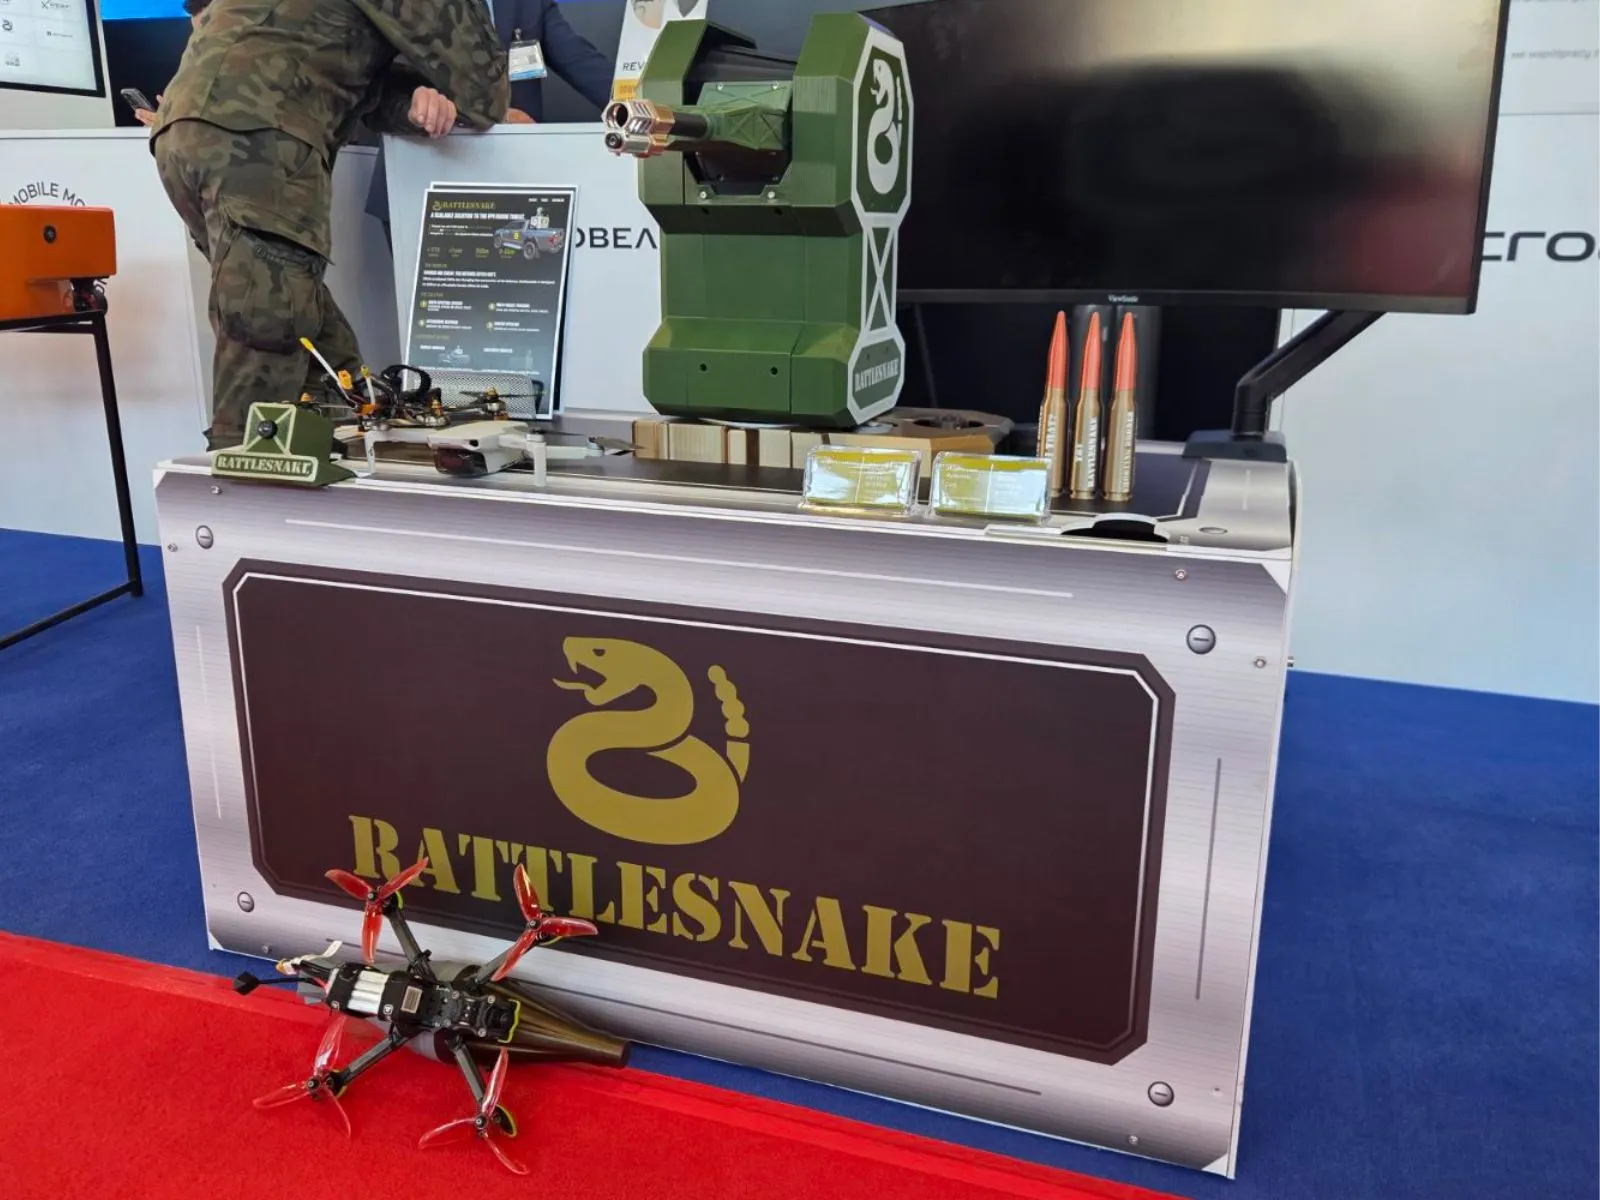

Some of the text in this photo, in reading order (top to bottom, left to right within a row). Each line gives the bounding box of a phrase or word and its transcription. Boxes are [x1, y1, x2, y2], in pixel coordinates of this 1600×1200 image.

[854, 358, 900, 393] RATTLESNAKE
[217, 455, 311, 475] RATTLESNAKE
[348, 814, 1001, 999] RATTLESNAKE
